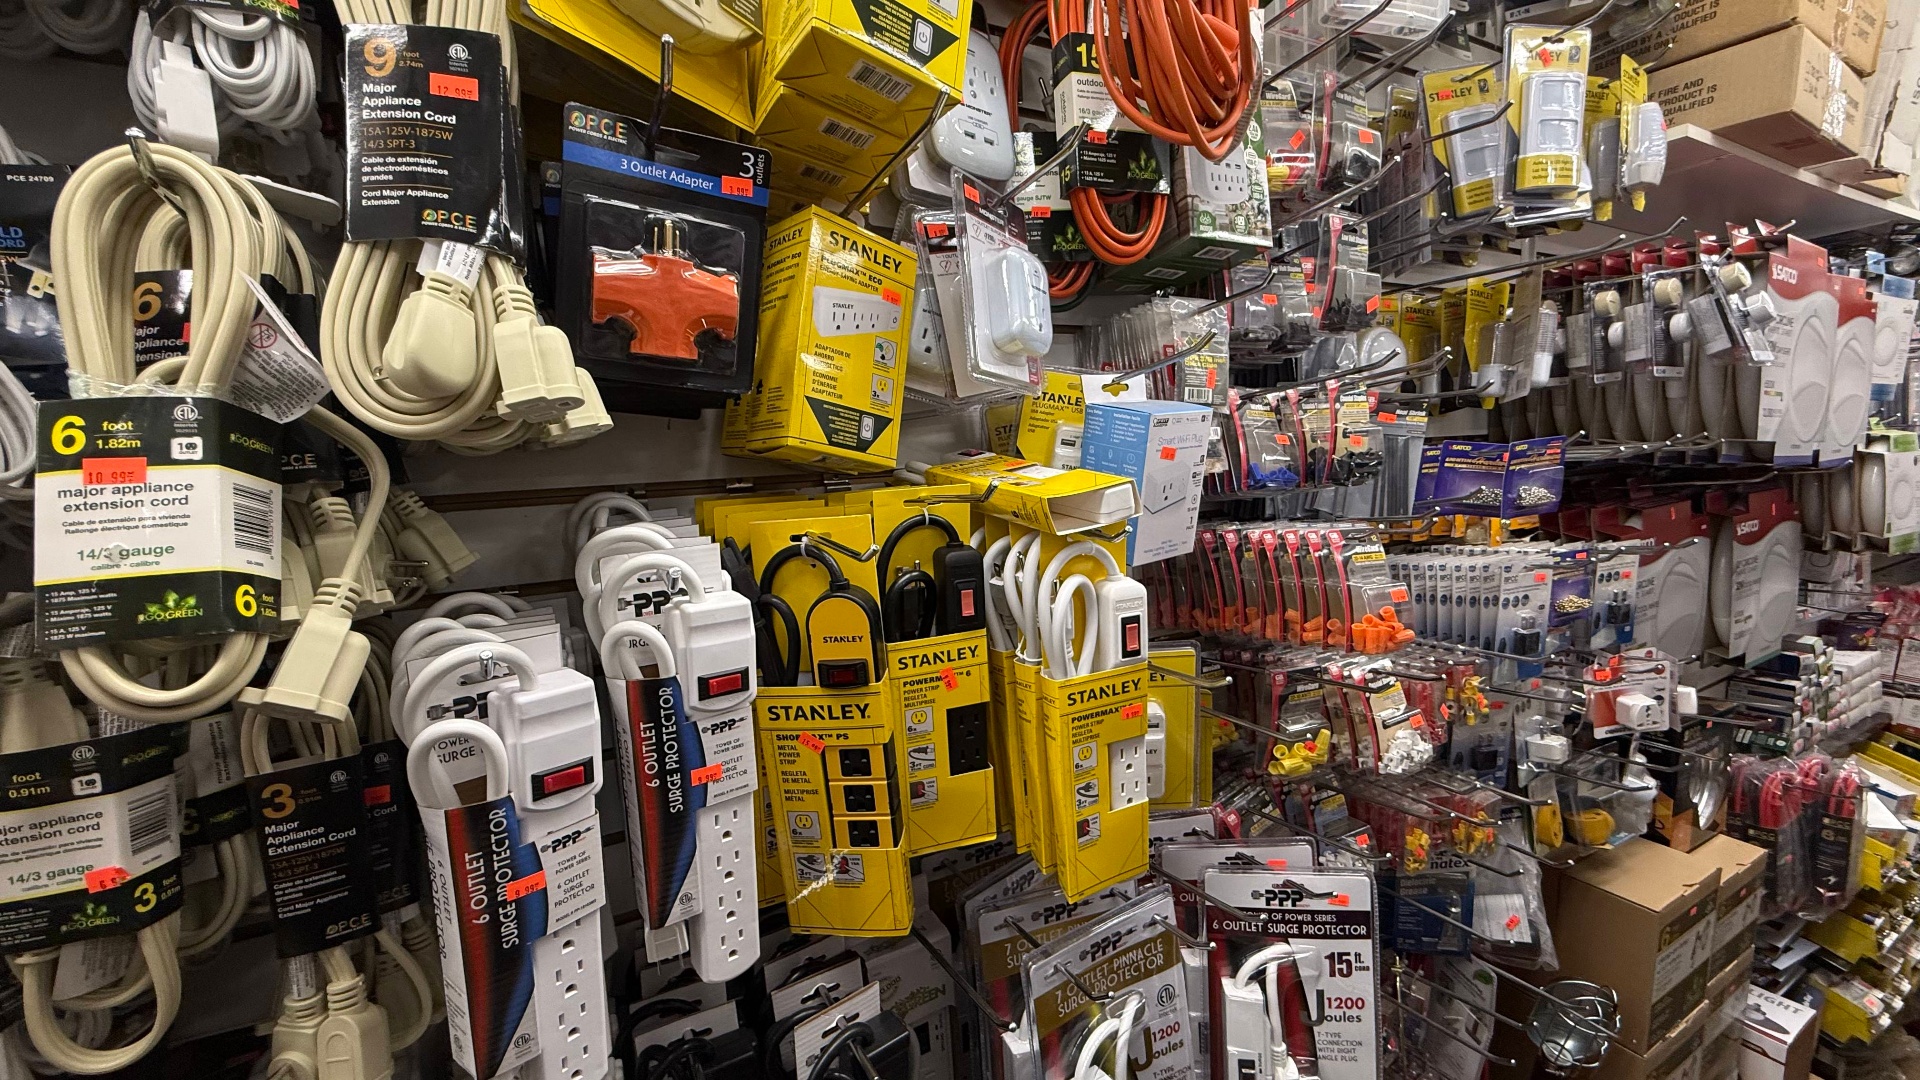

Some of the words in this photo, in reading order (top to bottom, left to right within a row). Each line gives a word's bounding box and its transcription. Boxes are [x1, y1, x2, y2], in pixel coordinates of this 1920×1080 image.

[364, 37, 397, 78] 9
[1622, 69, 1641, 88] STANLEY
[362, 83, 398, 94] Major
[1658, 86, 1680, 98] FIRE
[1682, 78, 1704, 92] AND
[362, 96, 422, 107] Appliance
[1586, 90, 1610, 102] STANLEY
[1659, 90, 1704, 108] PRODUCT
[1706, 84, 1718, 94] IS
[1662, 96, 1715, 117] QUALIFIED
[362, 109, 421, 120] Extension
[424, 110, 457, 125] Cord
[363, 127, 454, 141] 15A-125V-1875W
[363, 140, 385, 149] 14/3
[386, 140, 416, 149] SPT-3
[397, 156, 438, 166] extensión
[739, 151, 755, 178] 3
[373, 165, 449, 176] electrodomésticos
[621, 158, 628, 170] 3
[630, 161, 667, 180] Outlet
[669, 170, 714, 191] Adapter
[756, 153, 765, 185] outlets
[6, 174, 27, 182] PCE
[28, 175, 54, 183] 24709
[361, 174, 394, 183] grandes
[382, 189, 405, 198] Major
[406, 190, 449, 200] Appliance
[361, 198, 400, 206] Extension
[769, 227, 804, 251] STANLEY
[829, 230, 902, 274] STANLEY
[133, 281, 163, 321] 6
[1469, 288, 1494, 300] STANLEY
[1404, 306, 1436, 316] STANLEY
[813, 350, 835, 362] AHORRO
[811, 386, 843, 400] ADAPTATEUR
[1071, 406, 1084, 415] USB
[102, 420, 134, 431] foot
[51, 415, 86, 456] 6
[95, 438, 142, 449] 1.82m
[57, 485, 107, 499] major
[111, 481, 195, 496] appliance
[63, 498, 145, 513] extension
[149, 495, 189, 507] cord
[91, 563, 122, 571] calibre
[235, 584, 258, 617] 6
[261, 593, 275, 603] foot
[260, 607, 277, 617] 1.82m
[822, 635, 864, 644] STANLEY
[898, 645, 979, 670] STANLEY
[903, 688, 921, 696] POWER
[922, 685, 940, 693] STRIP
[904, 693, 928, 702] REGLETA
[1066, 678, 1142, 707] STANLEY
[904, 699, 936, 708] MULTIPRISE
[768, 702, 868, 722] STANLEY
[659, 686, 681, 769] PROTECTOR
[1071, 723, 1090, 732] POWER
[1071, 728, 1093, 739] REGLETA
[715, 740, 732, 749] TOWER
[1072, 733, 1100, 745] MULTIPRISE
[640, 721, 658, 775] OUTLET
[713, 746, 731, 756] POWER
[731, 743, 745, 751] SERIES
[720, 755, 743, 767] OUTLET
[12, 772, 42, 783] foot
[646, 778, 661, 788] 6
[712, 769, 749, 786] PROTECTOR
[8, 785, 50, 799] 0.91m
[667, 772, 684, 814] SURGE
[784, 787, 819, 796] MULTIPRISE
[261, 783, 296, 818] 3
[373, 804, 398, 817] Cord
[265, 821, 300, 834] Major
[266, 826, 325, 846] Appliance
[268, 836, 326, 857] Extension
[328, 828, 357, 842] Cord
[555, 860, 575, 875] POWER
[575, 855, 591, 867] SERIES
[557, 853, 578, 866] TOWER
[578, 850, 587, 859] OF
[7, 871, 42, 886] 14/3
[46, 863, 94, 881] gauge
[465, 852, 489, 910] OUTLET
[563, 868, 591, 887] OUTLET
[563, 881, 584, 896] SURGE
[134, 882, 157, 913] 3
[554, 883, 596, 909] PROTECTOR
[1264, 889, 1304, 907] PPP
[472, 914, 490, 925] 6
[1284, 913, 1312, 922] POWER
[1314, 914, 1337, 922] SERIES
[499, 902, 520, 949] SURGE
[1212, 920, 1219, 930] 6
[1222, 921, 1264, 933] OUTLET
[1267, 923, 1300, 935] SURGE
[1303, 924, 1367, 936] PROTECTOR
[1324, 951, 1353, 978] 15
[1301, 989, 1362, 1027] Joules
[1326, 997, 1366, 1010] 1200
[1151, 1021, 1181, 1043] 1200
[1317, 1031, 1342, 1039] T-TYPE
[1317, 1039, 1363, 1047] CONNECTION
[1317, 1054, 1339, 1062] ANGLE
[1340, 1055, 1358, 1063] PLUG
